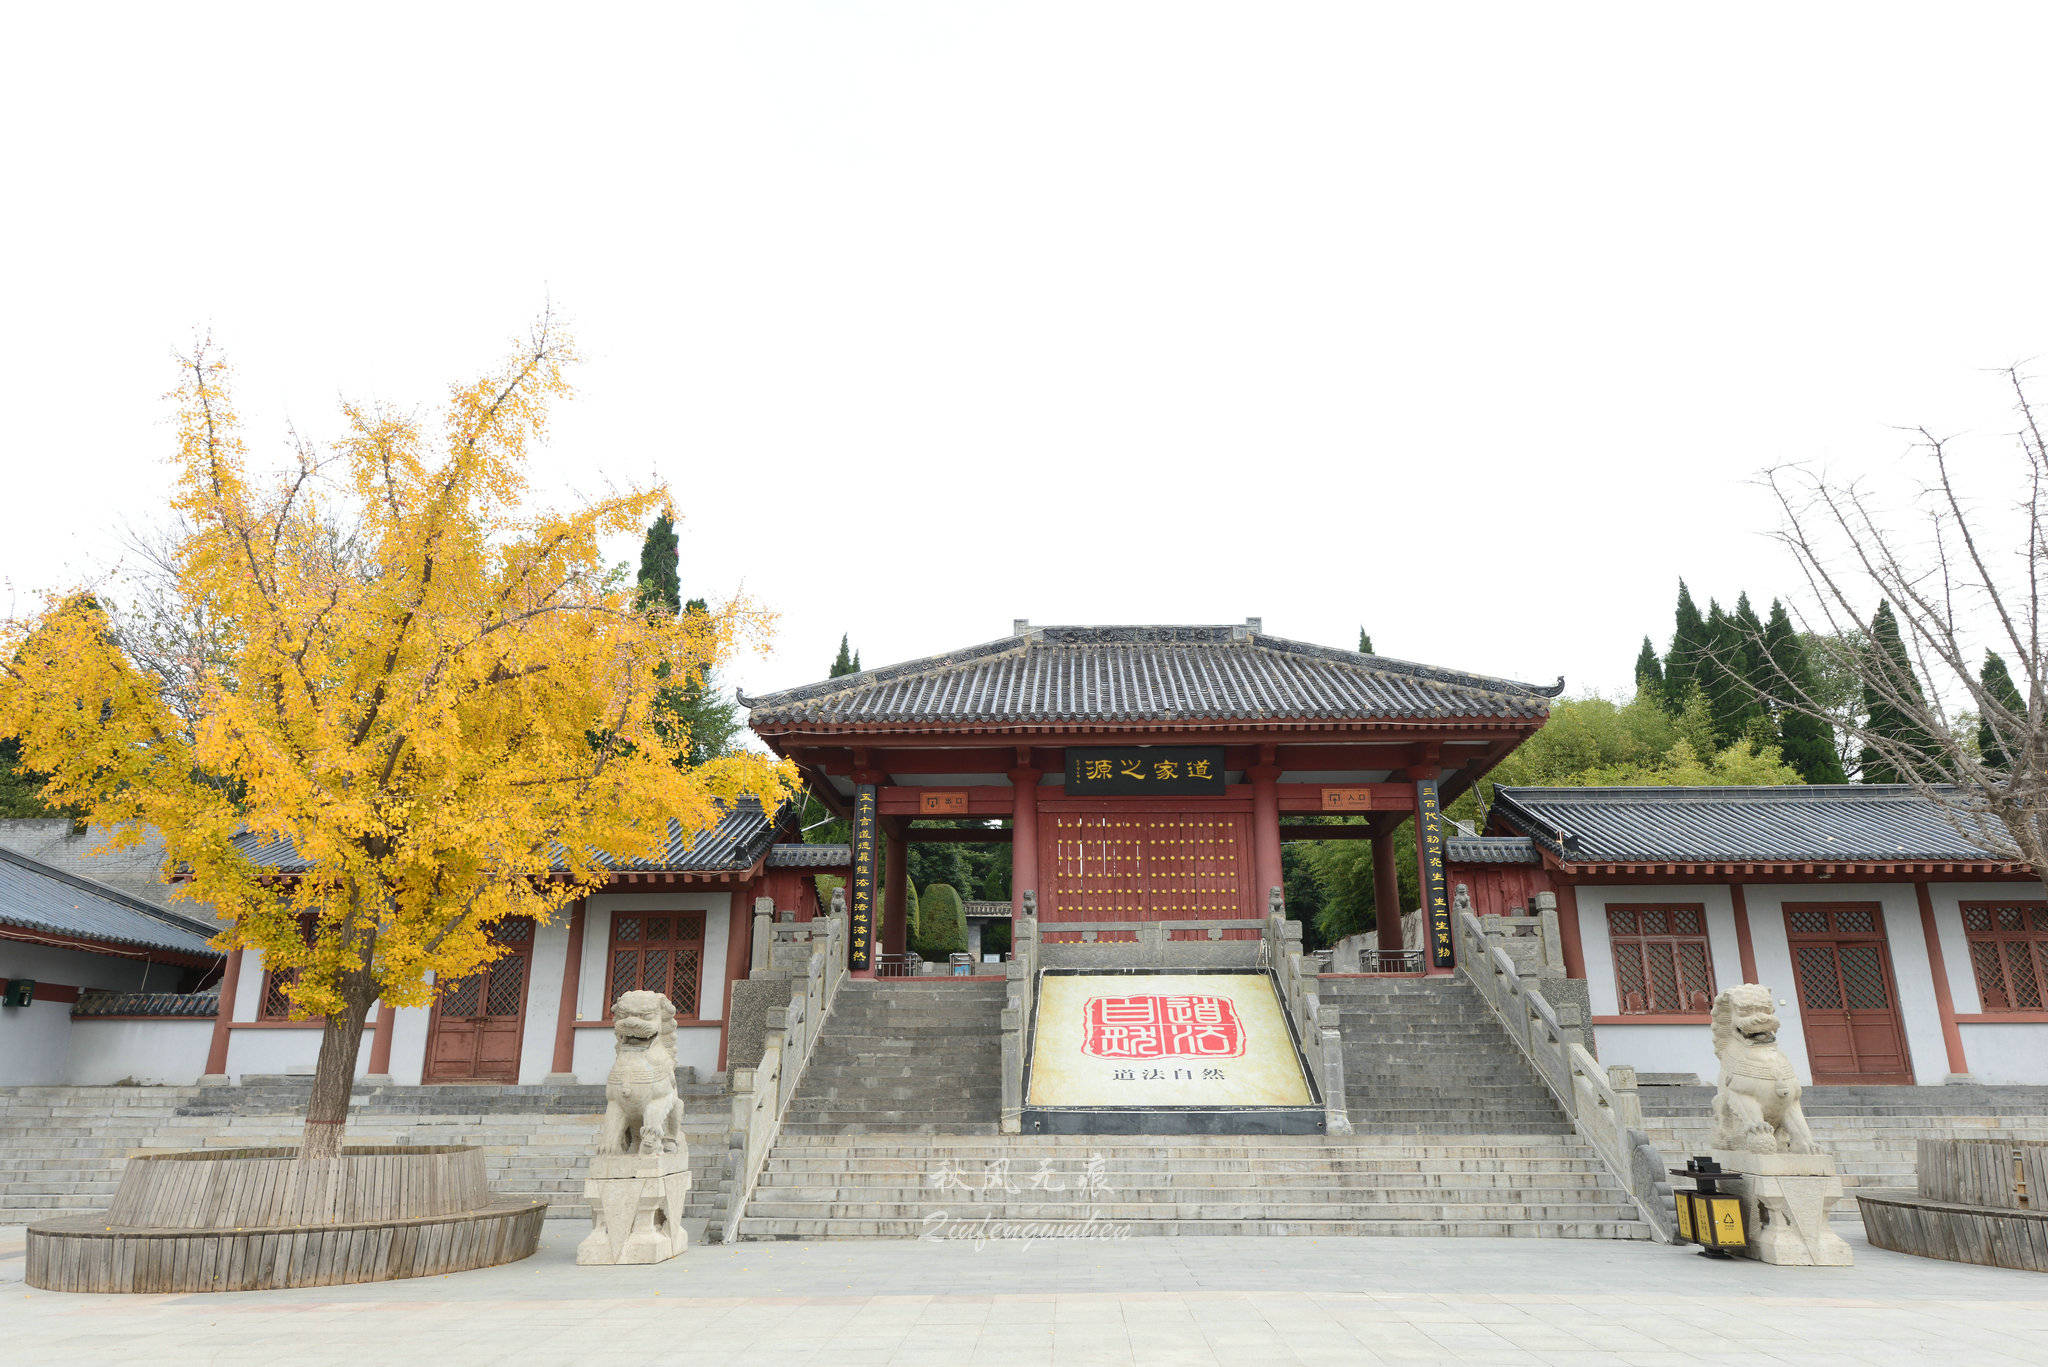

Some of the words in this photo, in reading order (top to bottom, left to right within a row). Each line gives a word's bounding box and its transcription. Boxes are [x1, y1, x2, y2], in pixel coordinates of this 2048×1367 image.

[1085, 759, 1213, 780] 道家之源
[1112, 1068, 1226, 1081] 道法自然
